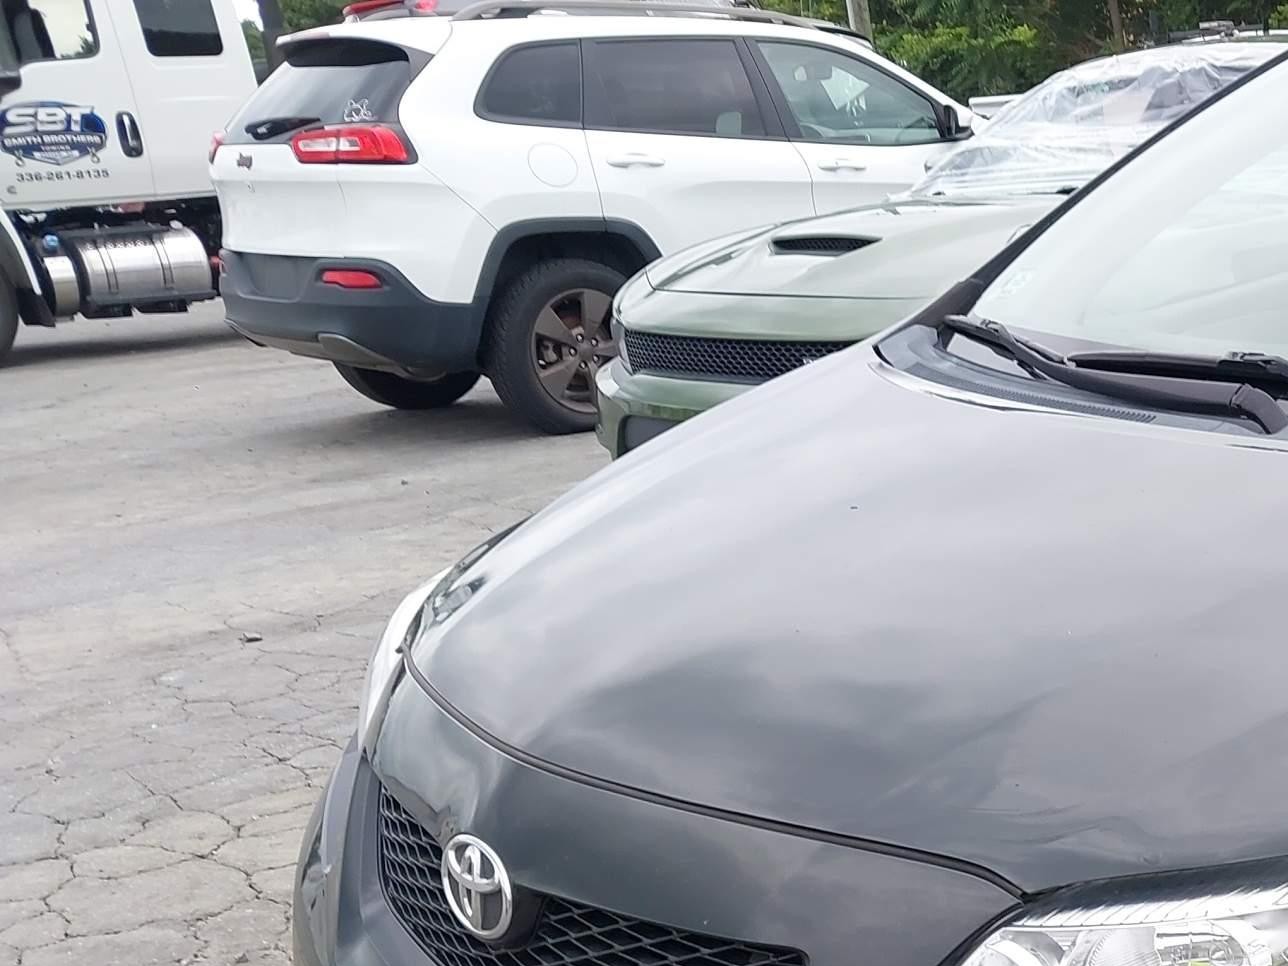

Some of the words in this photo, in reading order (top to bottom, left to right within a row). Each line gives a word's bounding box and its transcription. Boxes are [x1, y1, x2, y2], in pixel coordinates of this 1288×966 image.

[3, 105, 94, 135] SBT
[4, 135, 41, 147] SMITH
[42, 134, 101, 145] BROTHERS
